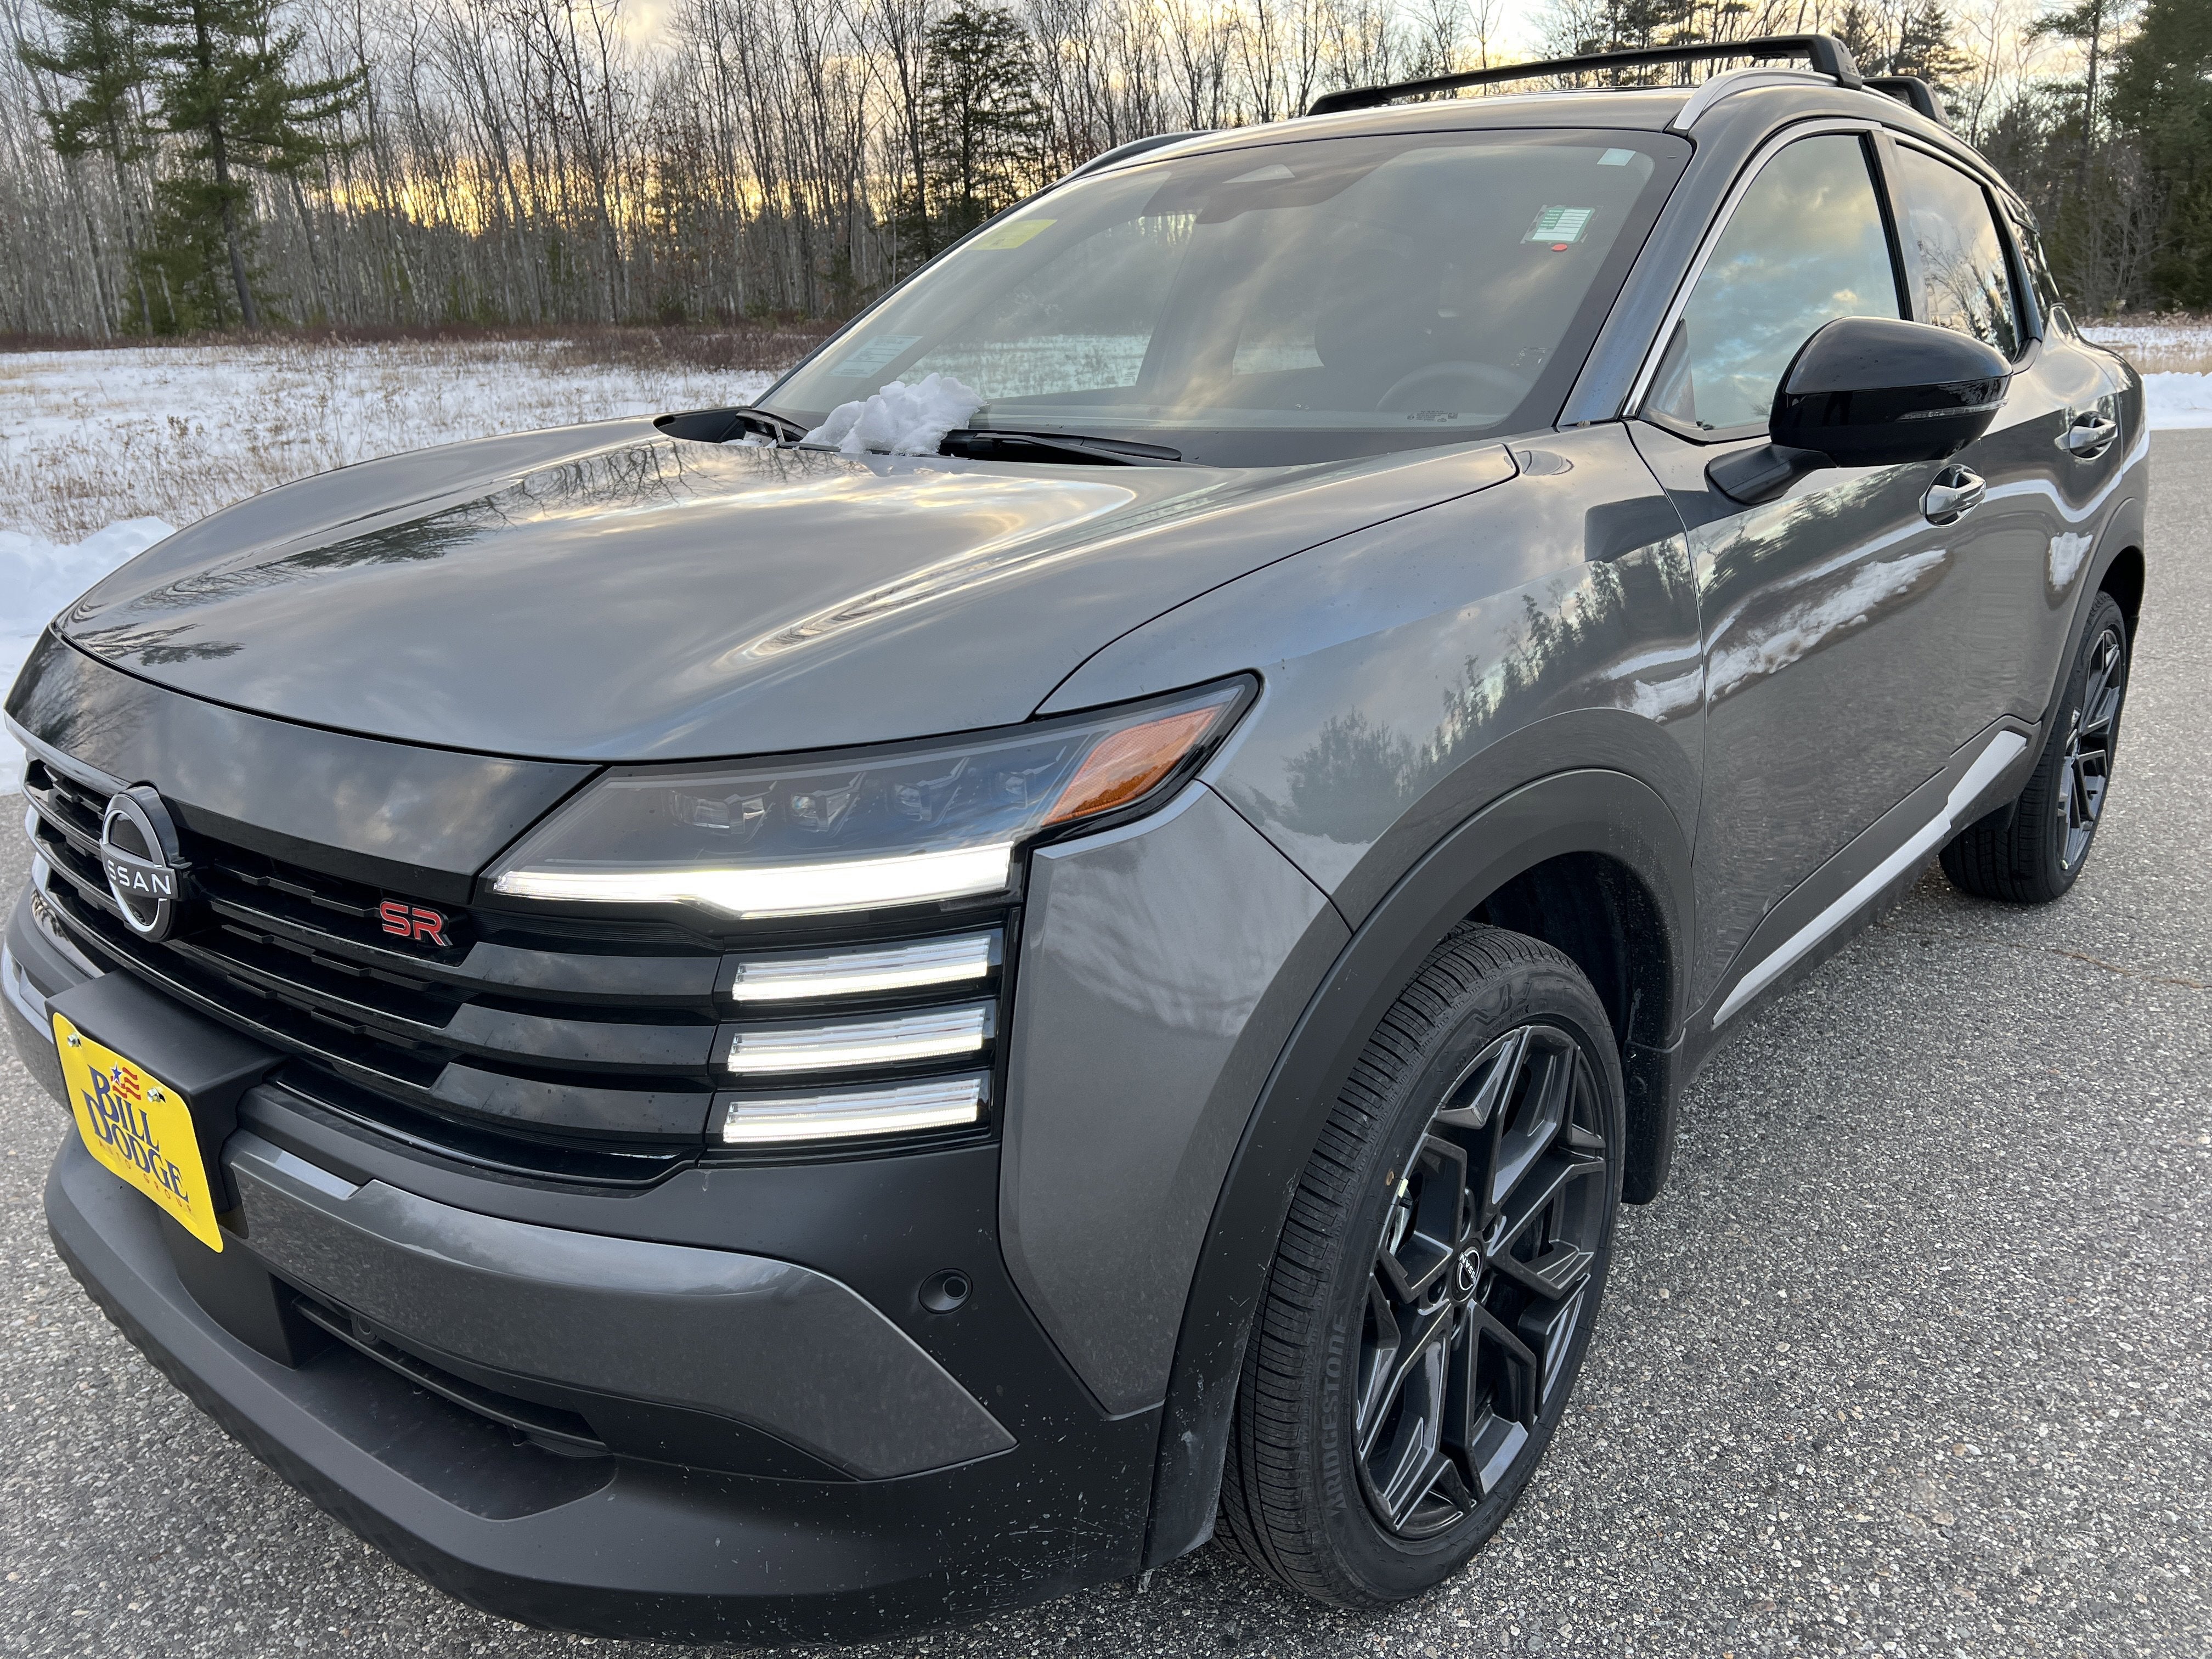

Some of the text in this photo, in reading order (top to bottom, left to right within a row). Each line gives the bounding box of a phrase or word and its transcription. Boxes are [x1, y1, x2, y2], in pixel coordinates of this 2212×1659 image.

[107, 859, 171, 895] SSAN
[380, 901, 449, 946] SR
[81, 1088, 189, 1203] DODGE
[88, 1064, 160, 1151] BILL
[1322, 1315, 1348, 1517] BRIDGESTONE
